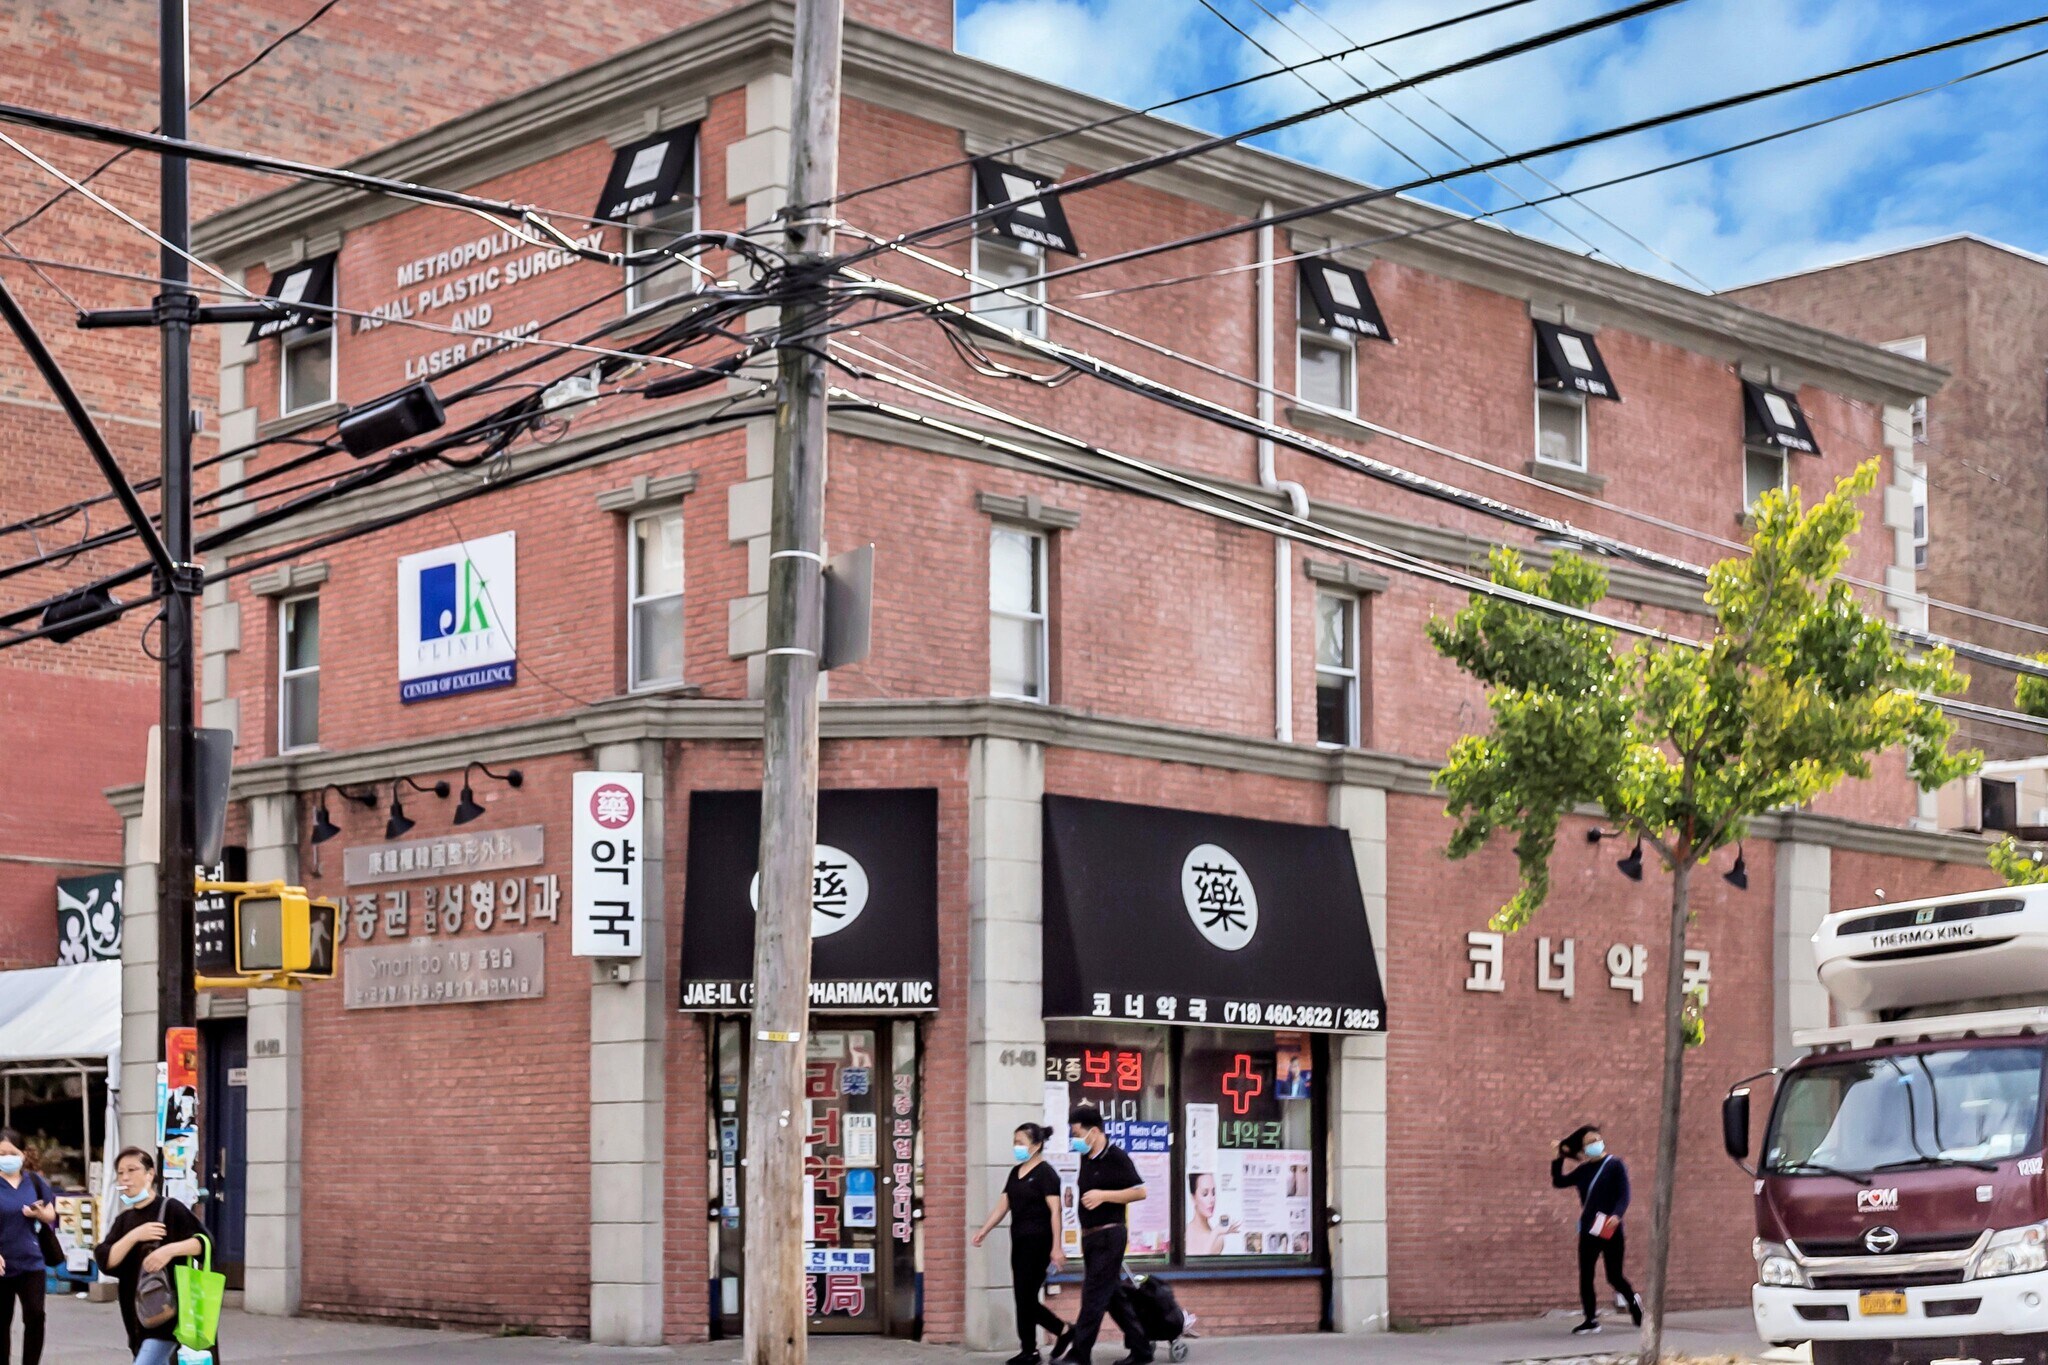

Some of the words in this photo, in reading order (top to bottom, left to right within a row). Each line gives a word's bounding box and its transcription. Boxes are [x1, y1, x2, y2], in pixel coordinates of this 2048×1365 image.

[354, 297, 413, 333] ACIAL
[418, 267, 499, 312] PLASTIC
[451, 303, 492, 331] AND
[405, 343, 467, 380] LASER
[417, 632, 495, 662] CLINIC
[440, 874, 561, 933] 성형외과
[589, 839, 635, 946] 약국
[1191, 862, 1249, 931] 藥
[1937, 922, 1974, 940] KING
[683, 983, 737, 1005] JAE-IL
[901, 981, 933, 1004] INC
[1223, 1001, 1262, 1025] (718)
[1083, 1049, 1143, 1092] 보험
[848, 1116, 871, 1128] OPEN
